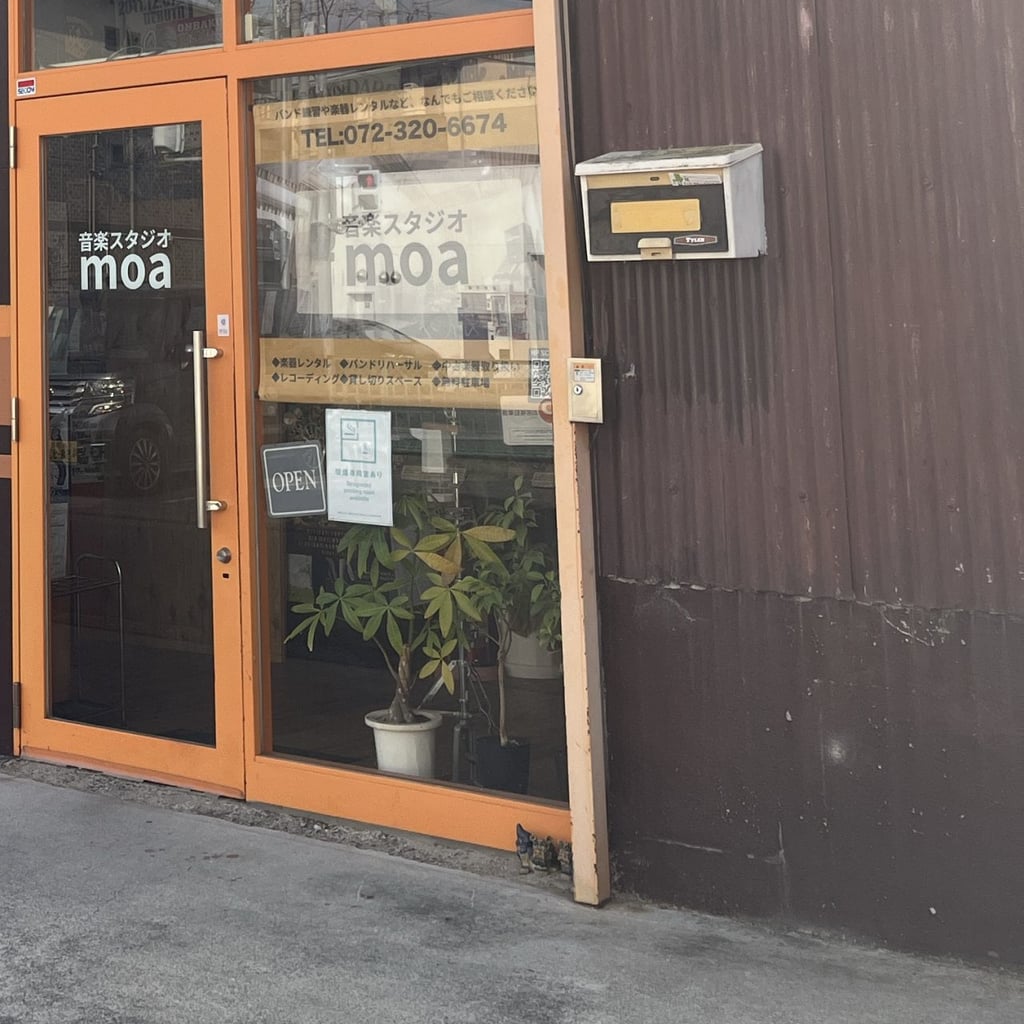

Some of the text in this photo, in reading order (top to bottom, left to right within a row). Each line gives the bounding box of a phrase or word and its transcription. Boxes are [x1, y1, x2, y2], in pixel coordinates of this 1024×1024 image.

[301, 112, 507, 148] TEL:072-320-6674
[342, 209, 468, 238] 音楽スタジオ
[79, 229, 171, 252] 音楽スタジオ
[80, 252, 172, 291] moa
[346, 240, 469, 287] moa
[272, 469, 317, 493] OPEN
